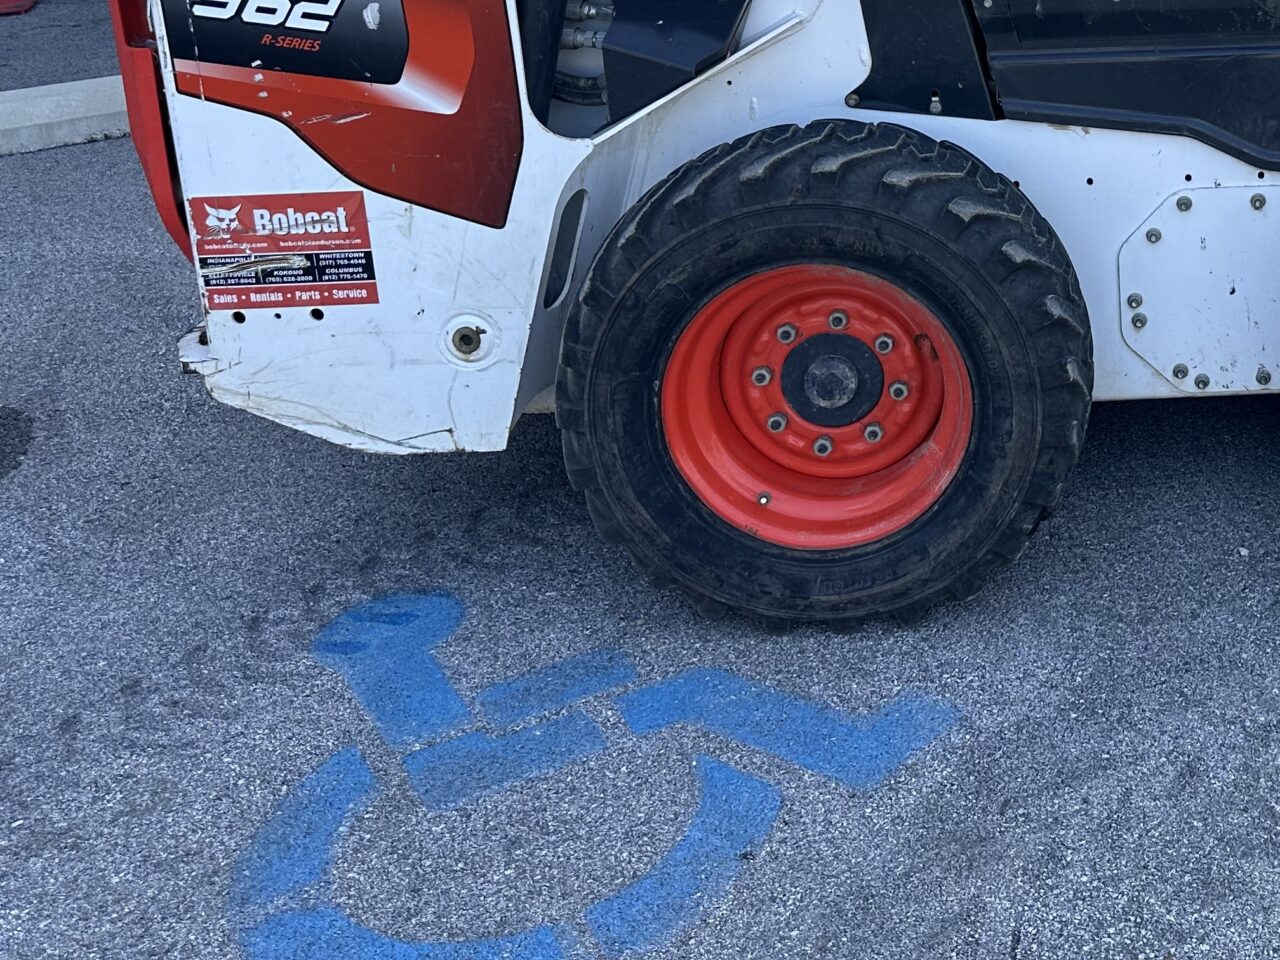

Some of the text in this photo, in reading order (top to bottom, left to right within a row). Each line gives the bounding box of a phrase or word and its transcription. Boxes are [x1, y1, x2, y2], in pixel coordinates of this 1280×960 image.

[261, 34, 321, 52] R-SERIES
[252, 207, 349, 236] Bobcat
[325, 266, 363, 274] COLUMBUS
[213, 288, 368, 304] Sales Rentals Parts Service
